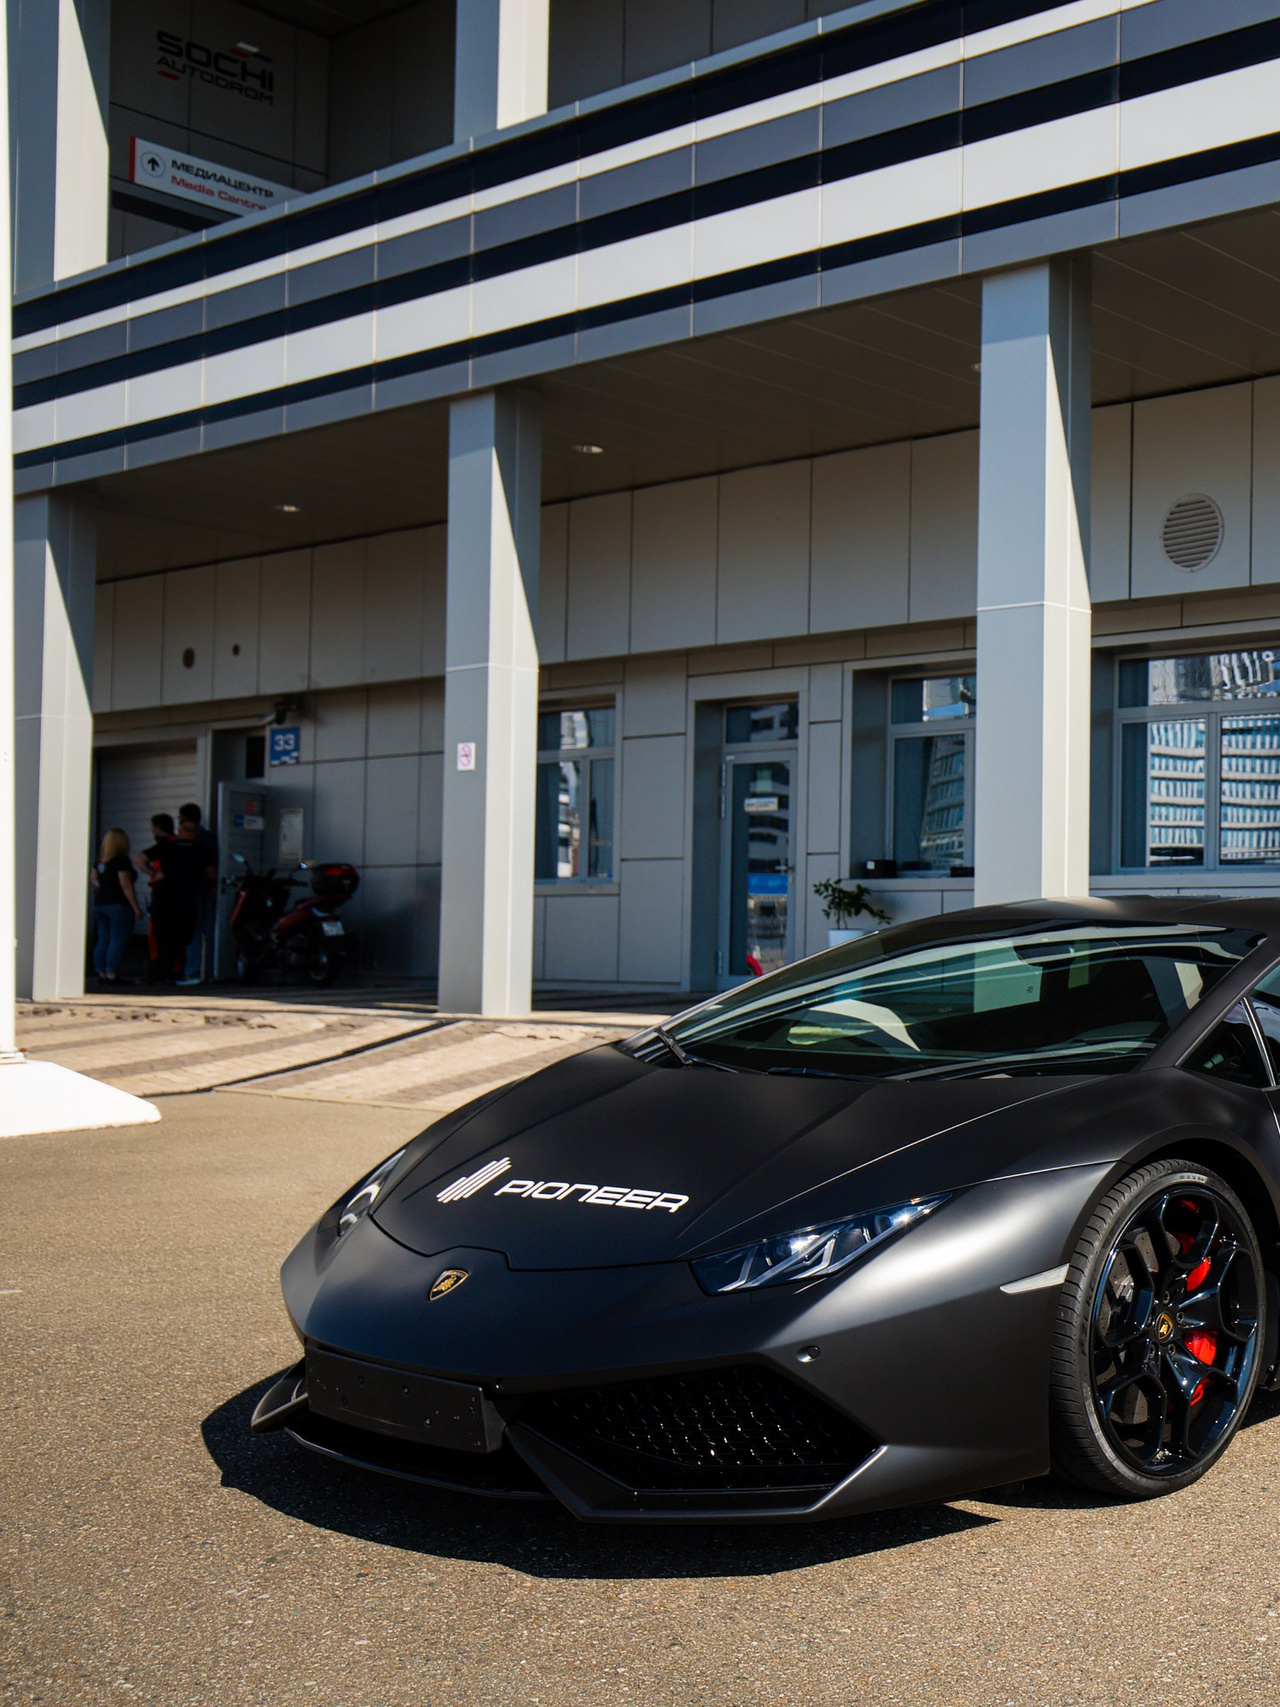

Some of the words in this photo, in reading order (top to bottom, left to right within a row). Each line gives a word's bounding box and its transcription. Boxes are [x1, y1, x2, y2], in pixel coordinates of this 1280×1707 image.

[156, 30, 274, 92] SOCHI
[156, 56, 274, 105] AUTODROM
[171, 159, 274, 198] МЕДИАЦЕНТР
[171, 175, 215, 197] Media
[218, 189, 267, 211] Centre
[274, 733, 296, 752] 33
[494, 1179, 690, 1213] PIONEER
